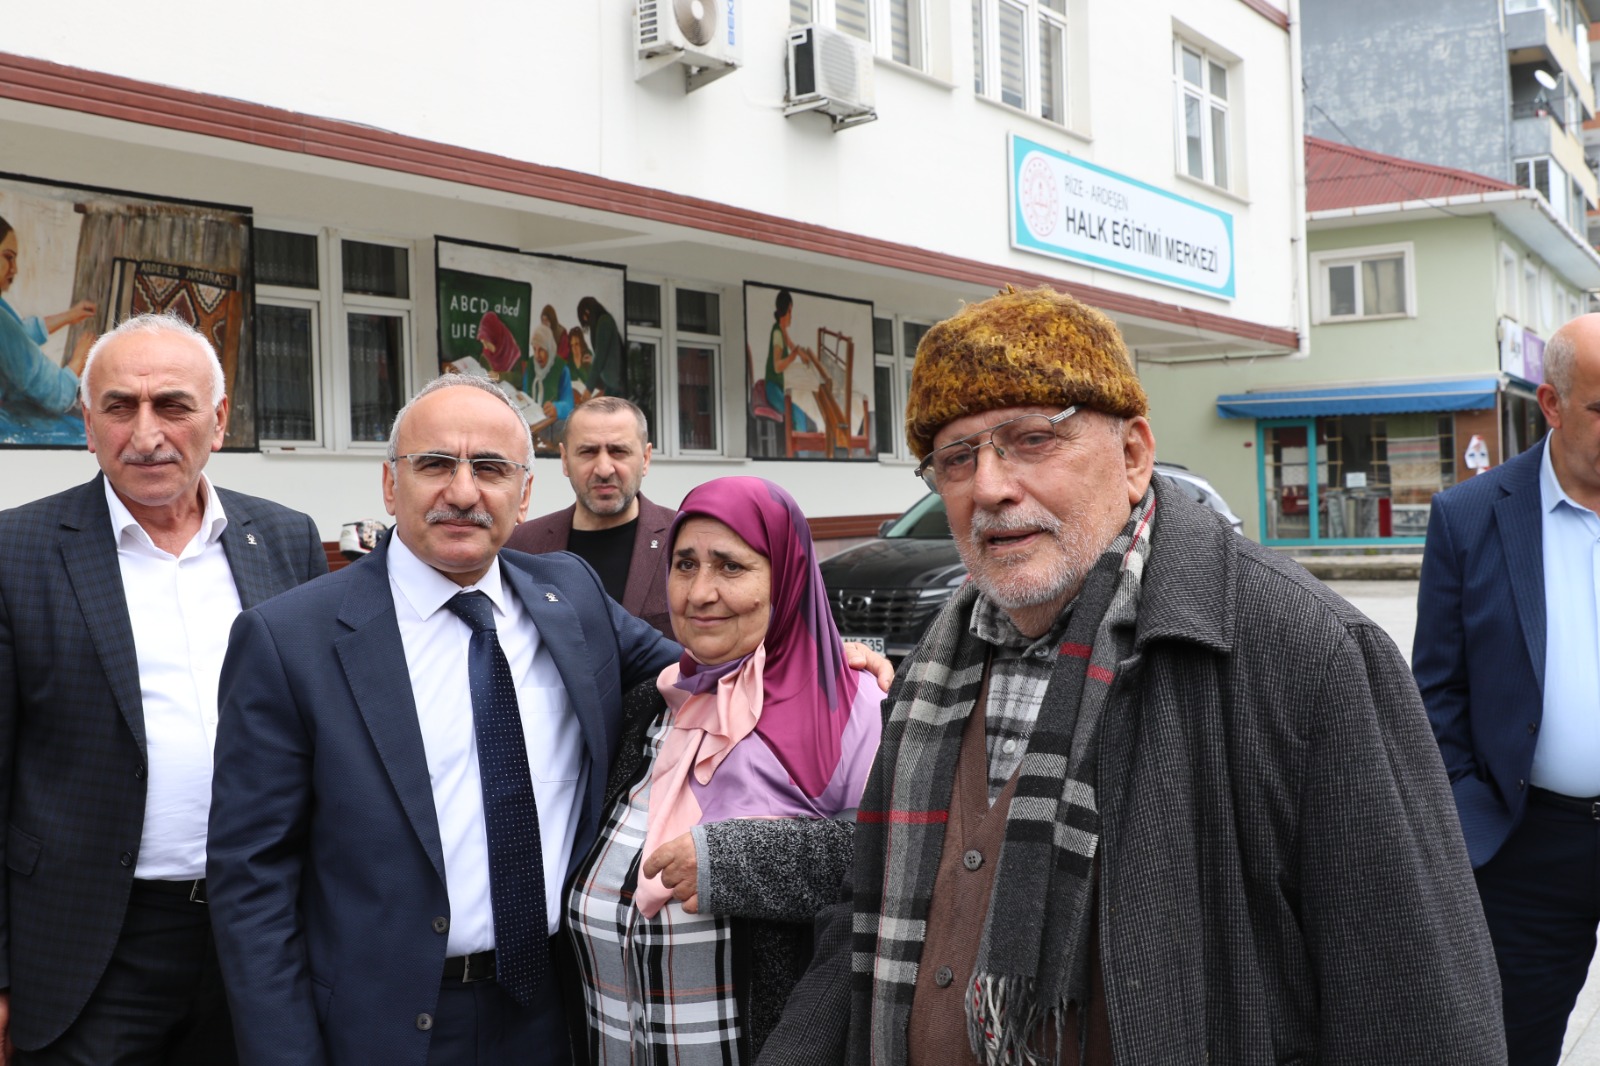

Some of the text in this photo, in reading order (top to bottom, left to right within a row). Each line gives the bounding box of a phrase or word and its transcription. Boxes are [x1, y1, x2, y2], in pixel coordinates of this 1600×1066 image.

[727, 0, 736, 46] BEK
[1066, 206, 1218, 273] HALK EĞİTİMİ MERKEZİ
[450, 295, 521, 317] ABCD abcd
